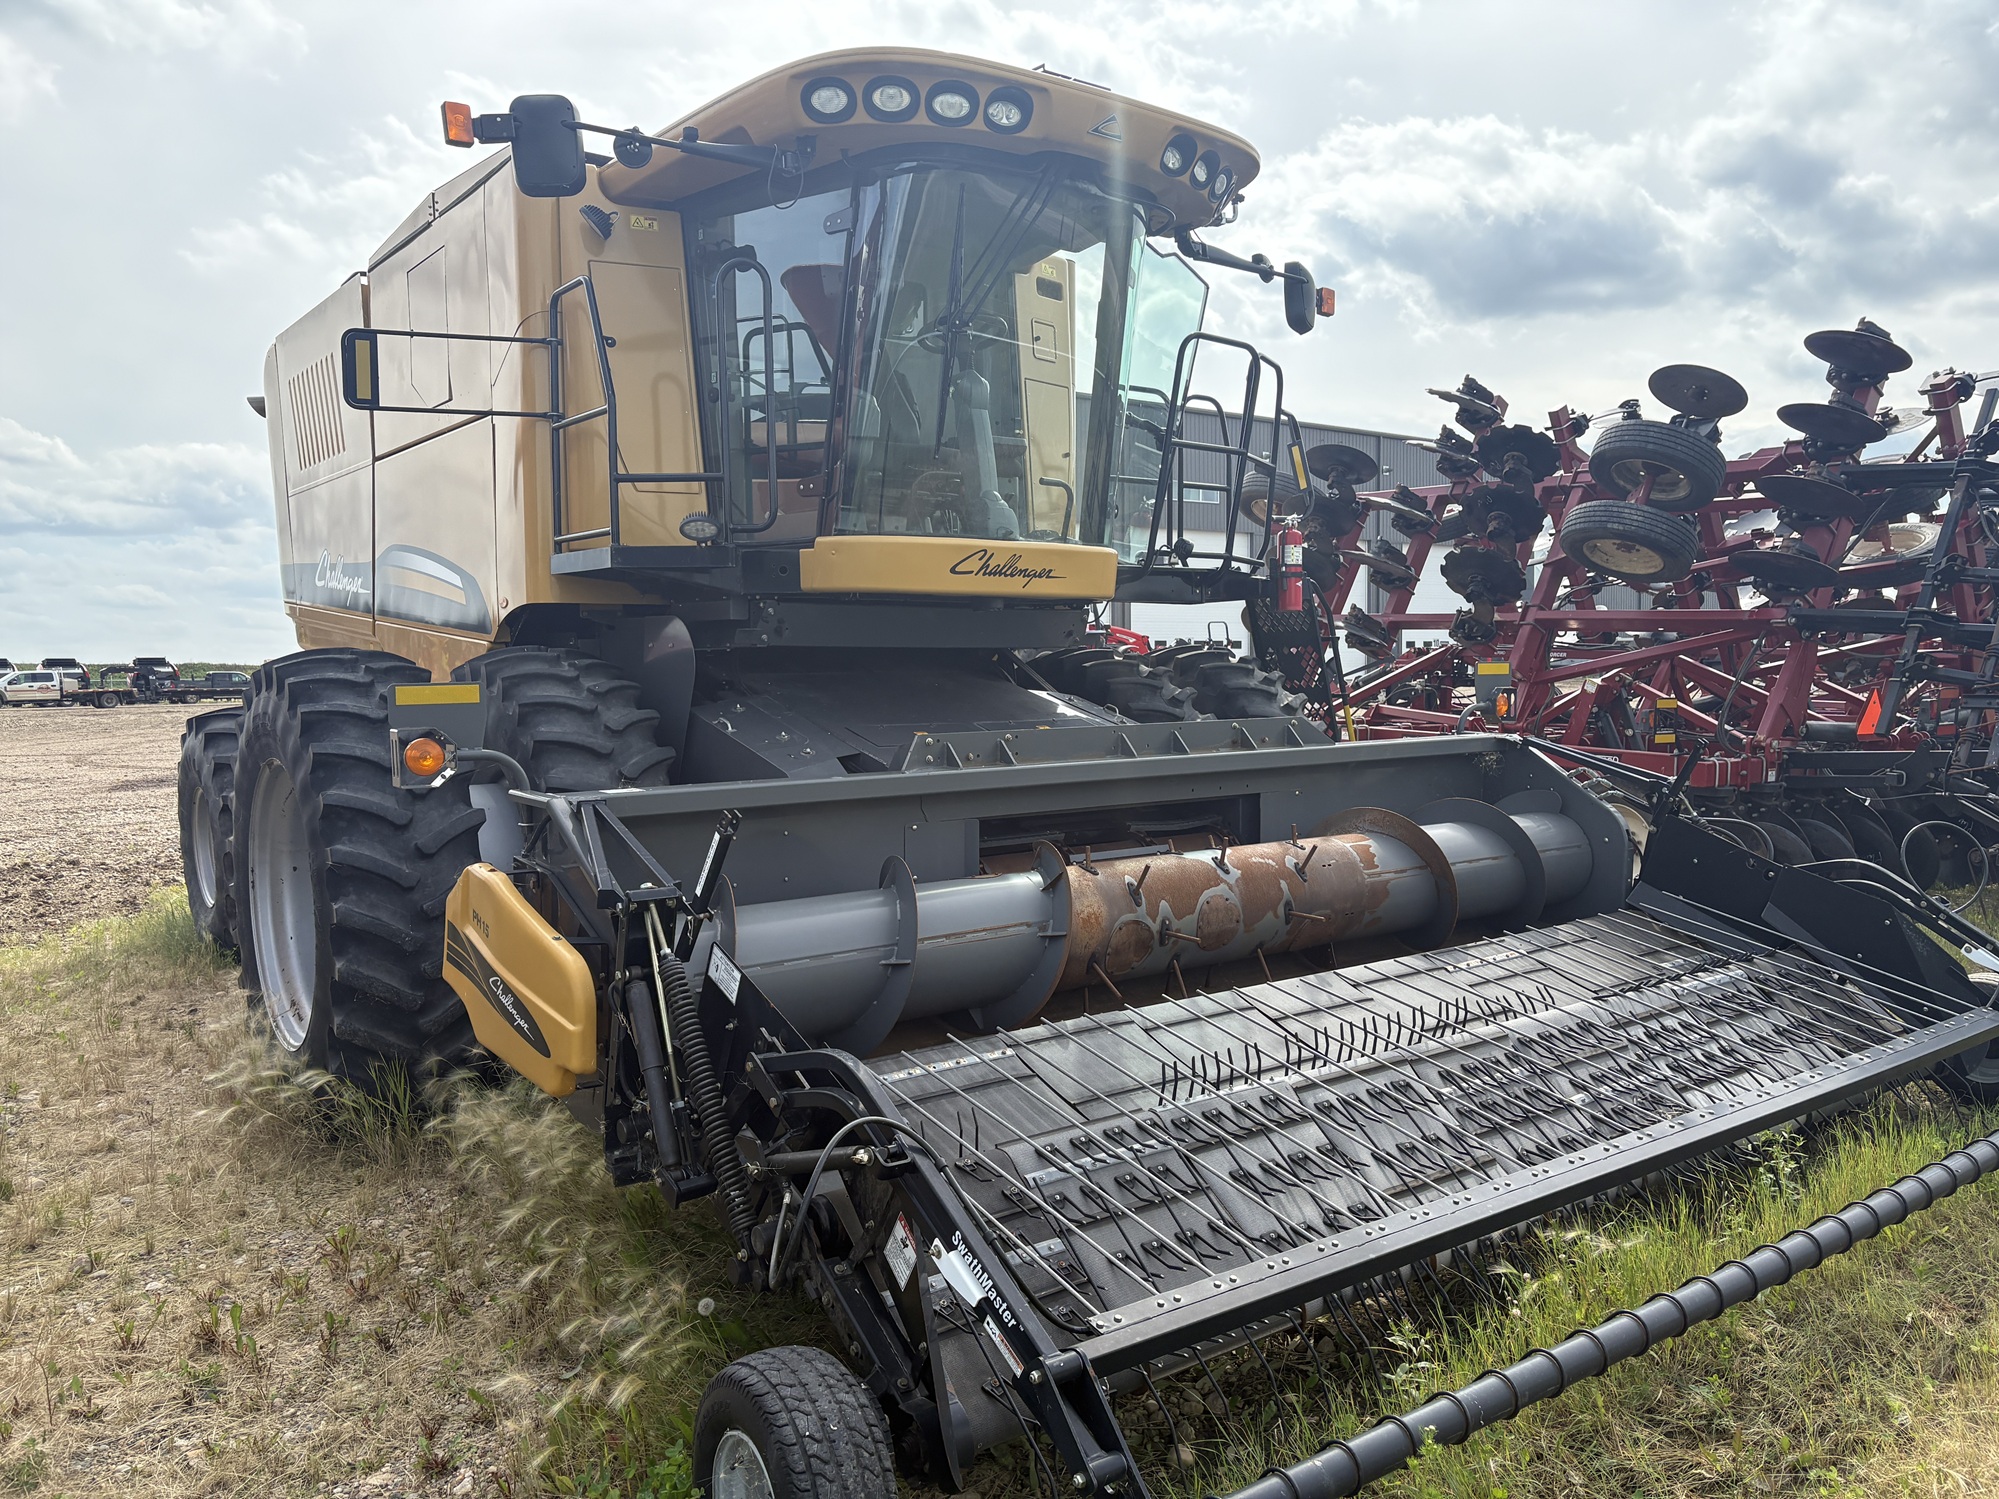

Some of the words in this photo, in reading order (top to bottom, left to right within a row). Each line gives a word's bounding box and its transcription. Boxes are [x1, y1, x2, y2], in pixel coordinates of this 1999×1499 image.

[315, 549, 371, 607] Challenger
[949, 548, 1067, 589] Challenger
[489, 976, 535, 1041] Challenger
[952, 1230, 1017, 1329] SwathMaster
